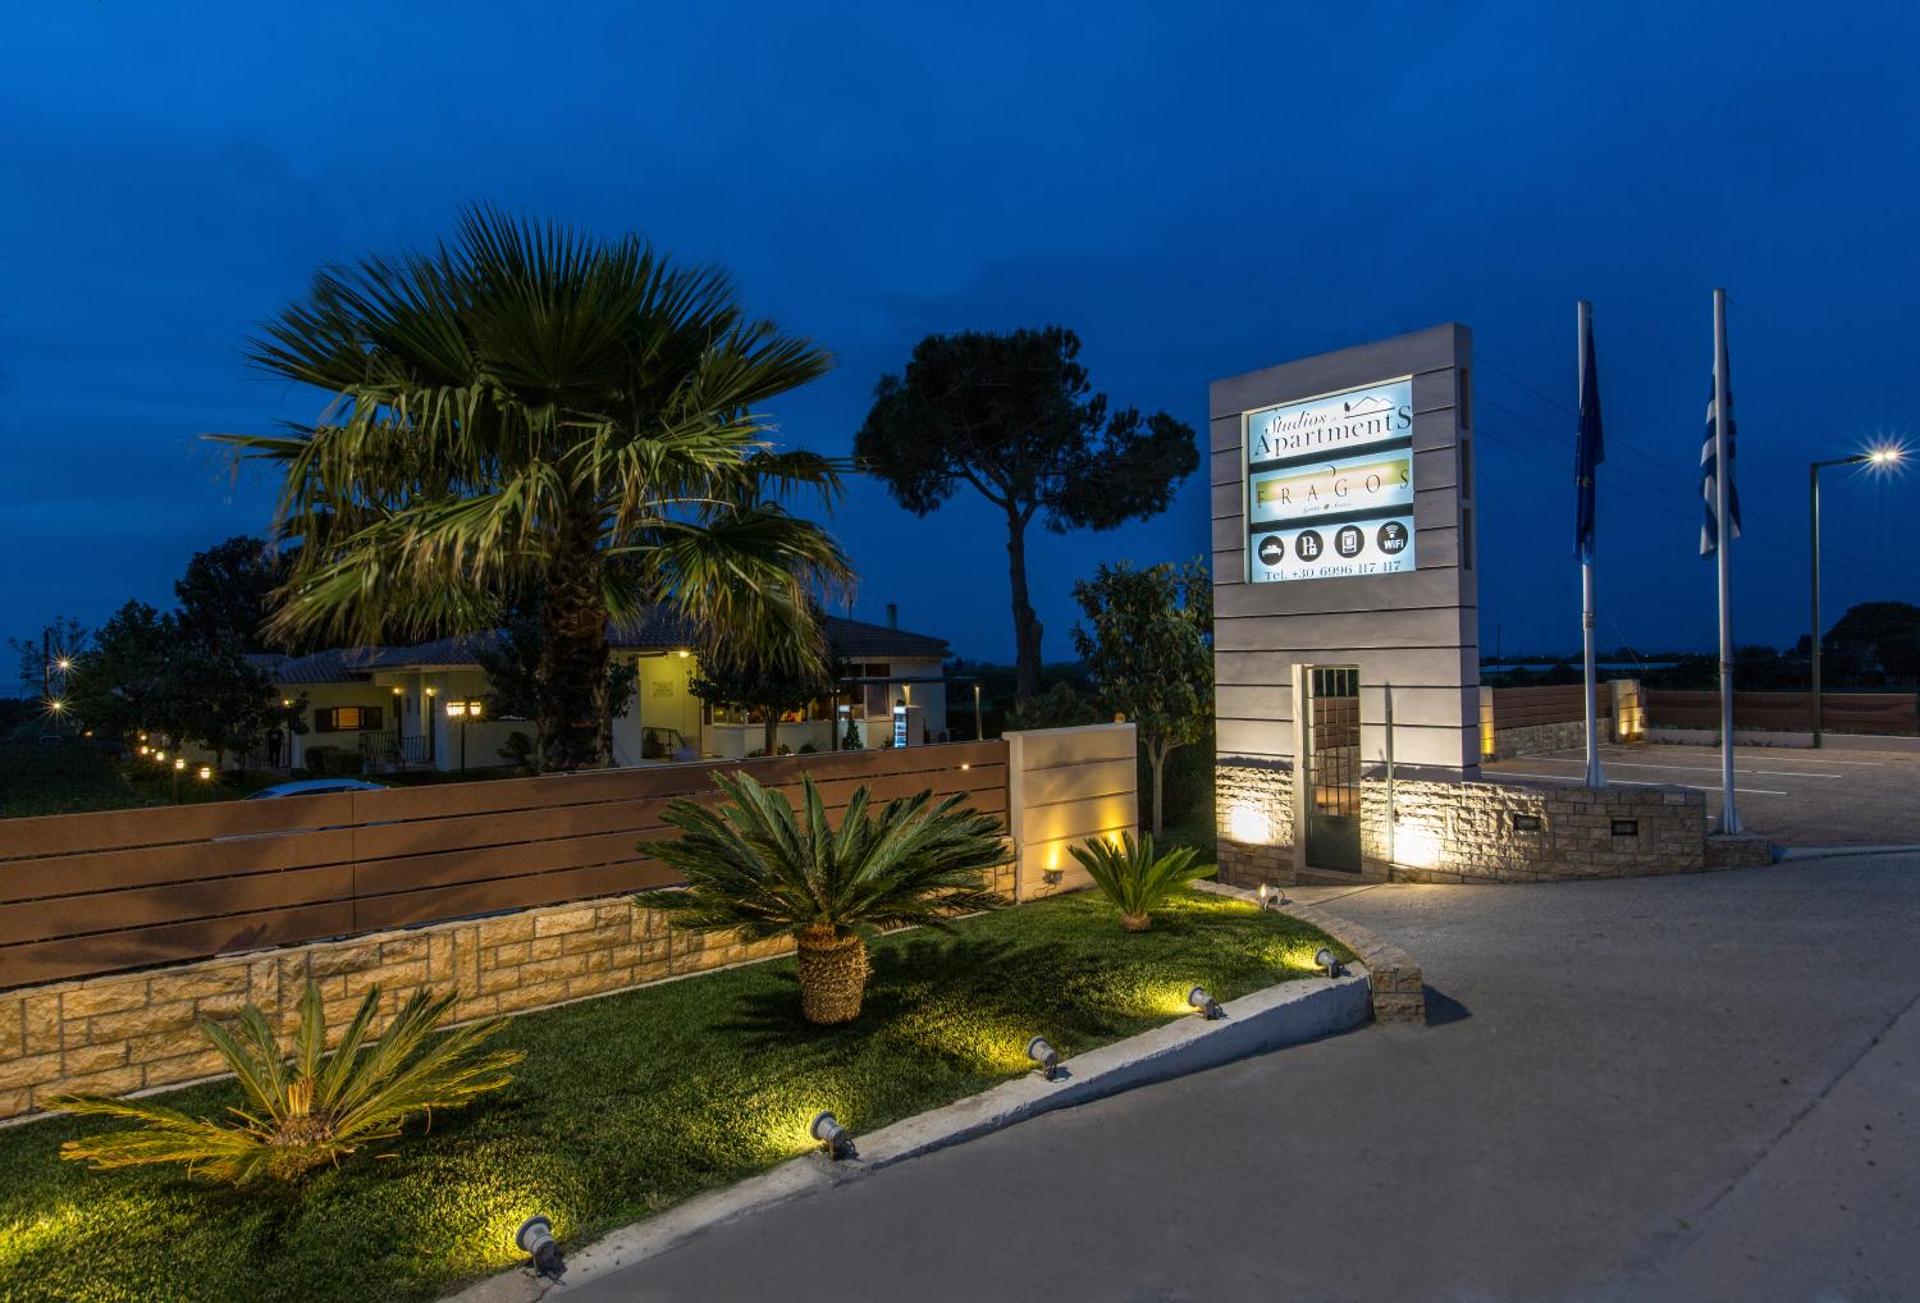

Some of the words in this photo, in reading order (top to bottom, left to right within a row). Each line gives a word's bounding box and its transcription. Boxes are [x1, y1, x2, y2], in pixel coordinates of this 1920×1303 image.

[1264, 411, 1326, 433] Studios
[1257, 469, 1408, 508] FRAGOS
[1292, 567, 1314, 579] +30
[1320, 564, 1353, 577] 6996
[1359, 562, 1376, 574] 117
[1383, 560, 1401, 572] 117
